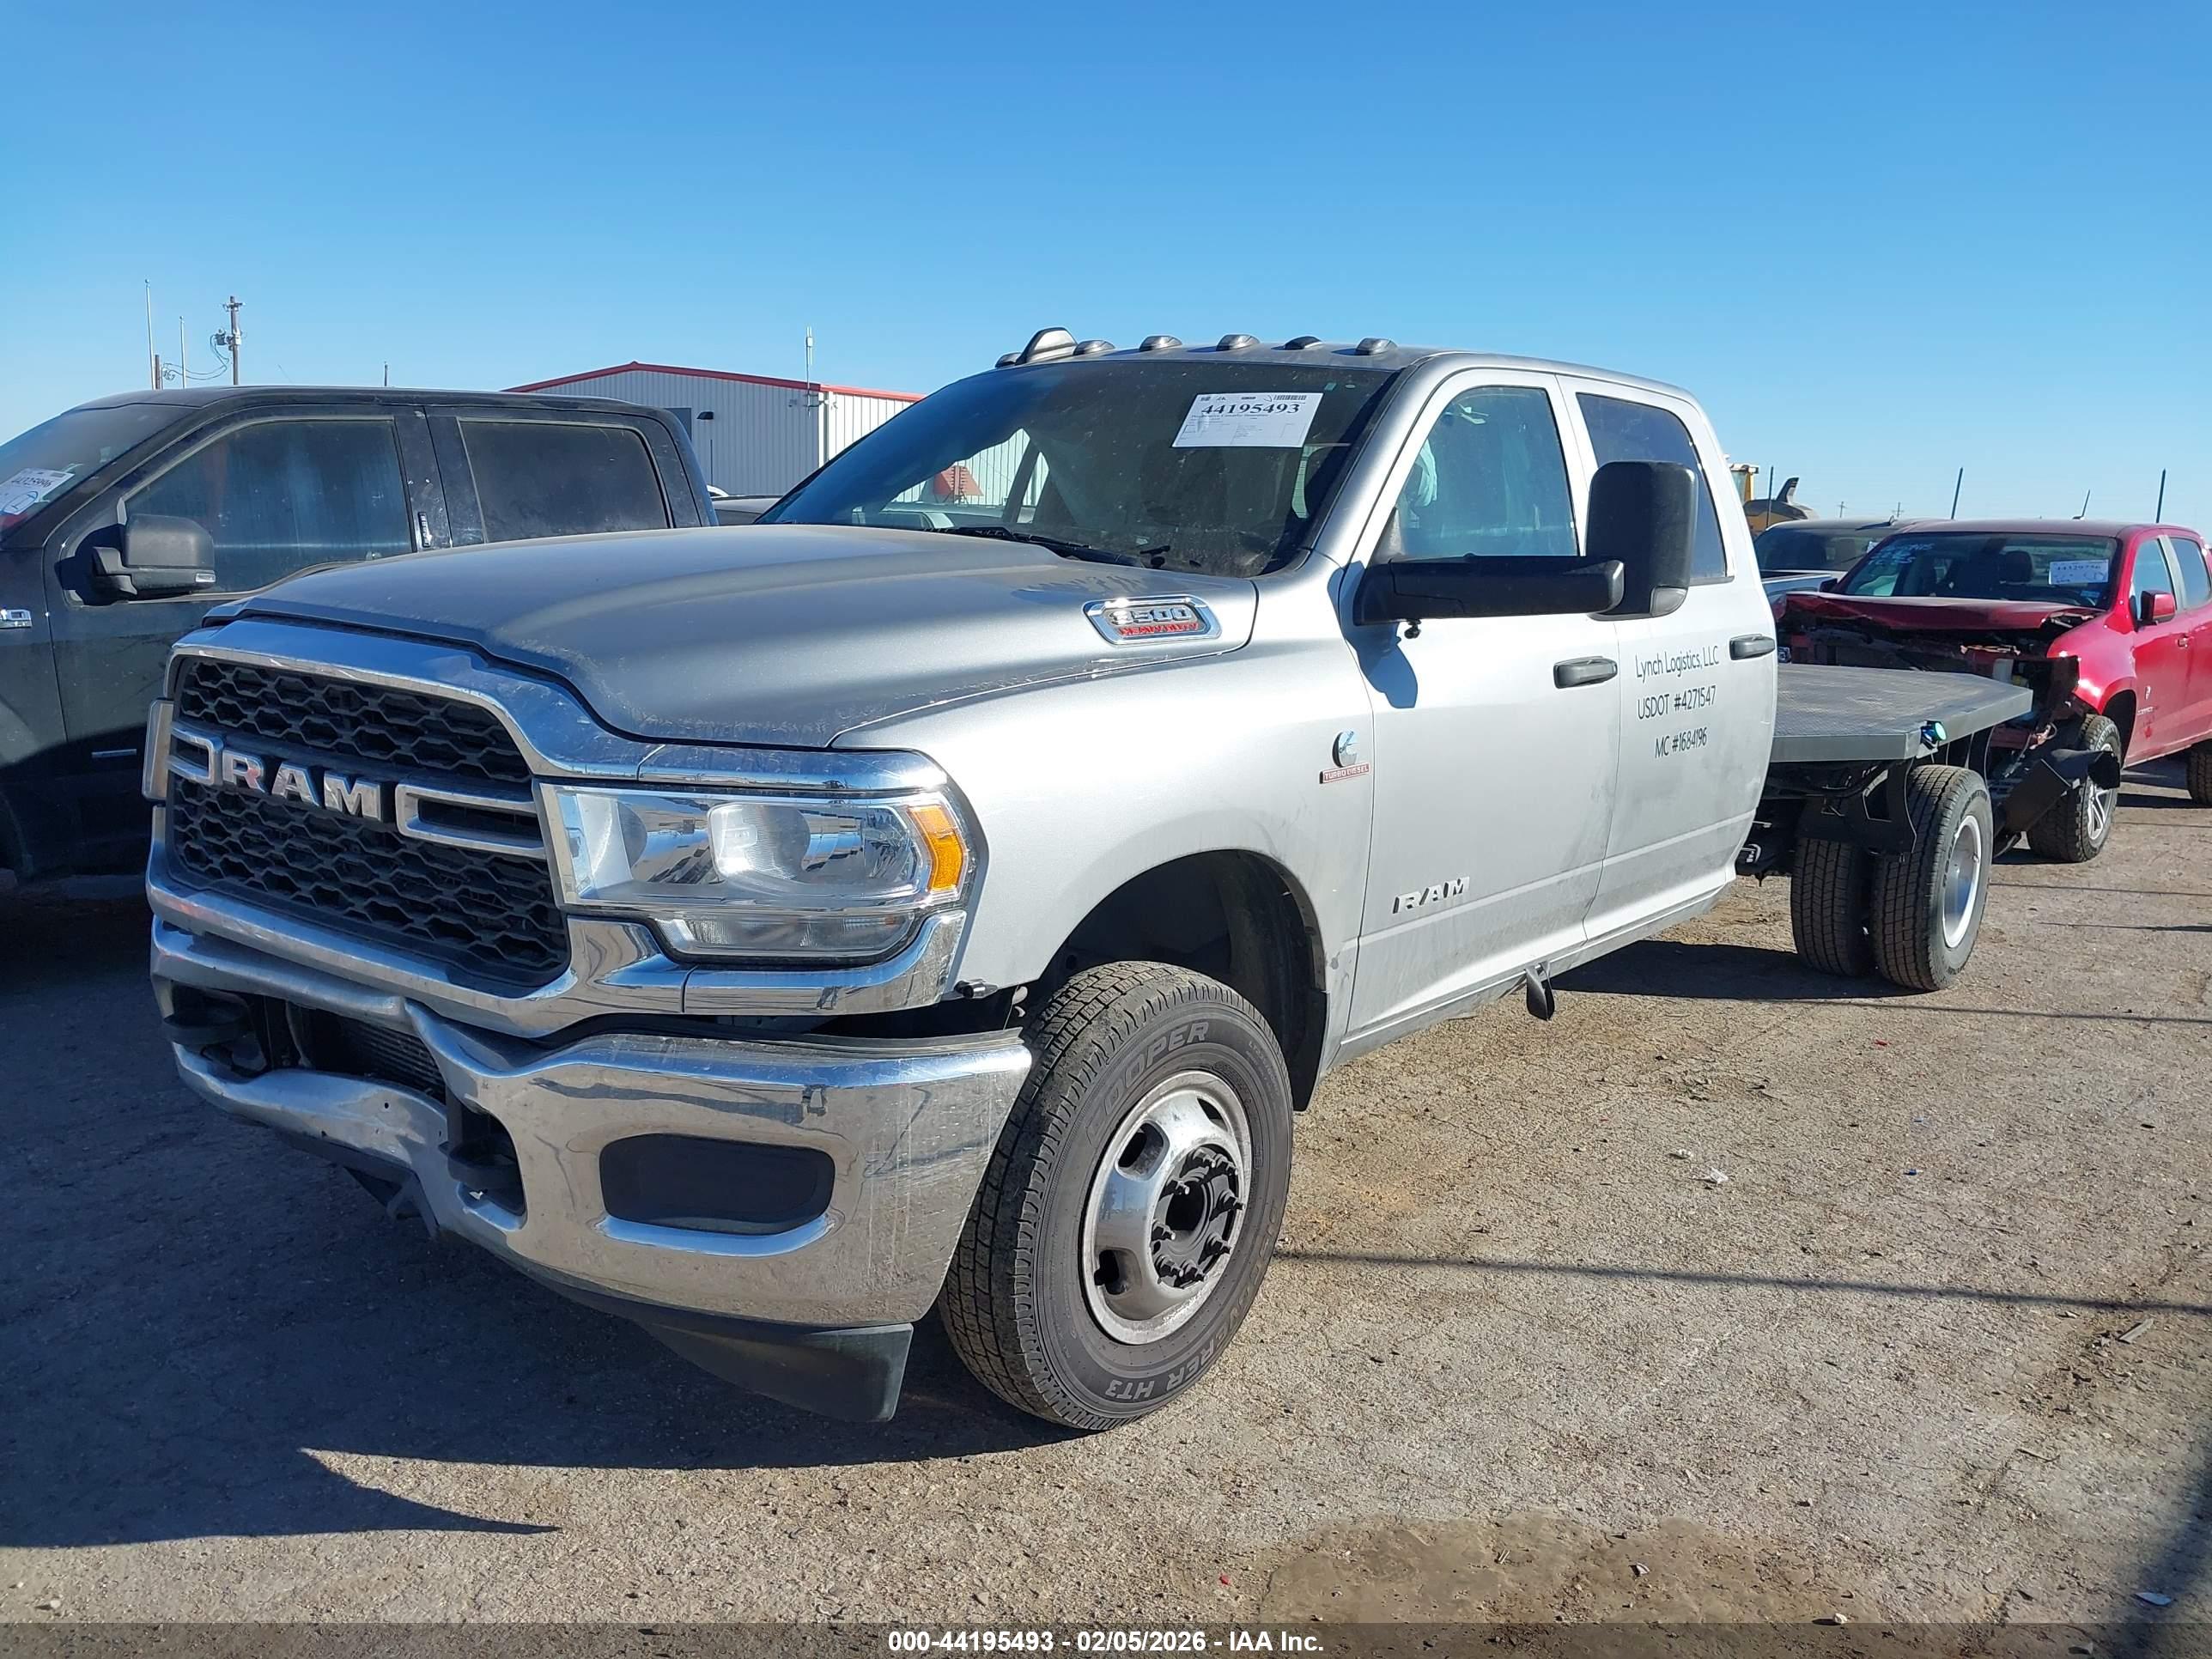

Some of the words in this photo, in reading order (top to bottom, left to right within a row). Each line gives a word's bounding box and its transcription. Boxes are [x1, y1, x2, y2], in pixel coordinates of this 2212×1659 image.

[1201, 403, 1300, 414] 44195493
[1635, 653, 1664, 684] Lynch
[1664, 650, 1703, 678] Logistics,
[1703, 645, 1719, 667] LLC
[1638, 693, 1670, 720] USDOT
[1674, 684, 1717, 712] #4271547
[1655, 735, 1670, 759] MC
[1671, 726, 1708, 753] #1684196
[222, 749, 383, 822] RAM
[1324, 769, 1346, 781] TURBO
[1346, 763, 1369, 776] DIESEL
[1392, 876, 1470, 915] RAM
[1085, 1021, 1209, 1146] COOPER
[1104, 1378, 1156, 1401] HT3
